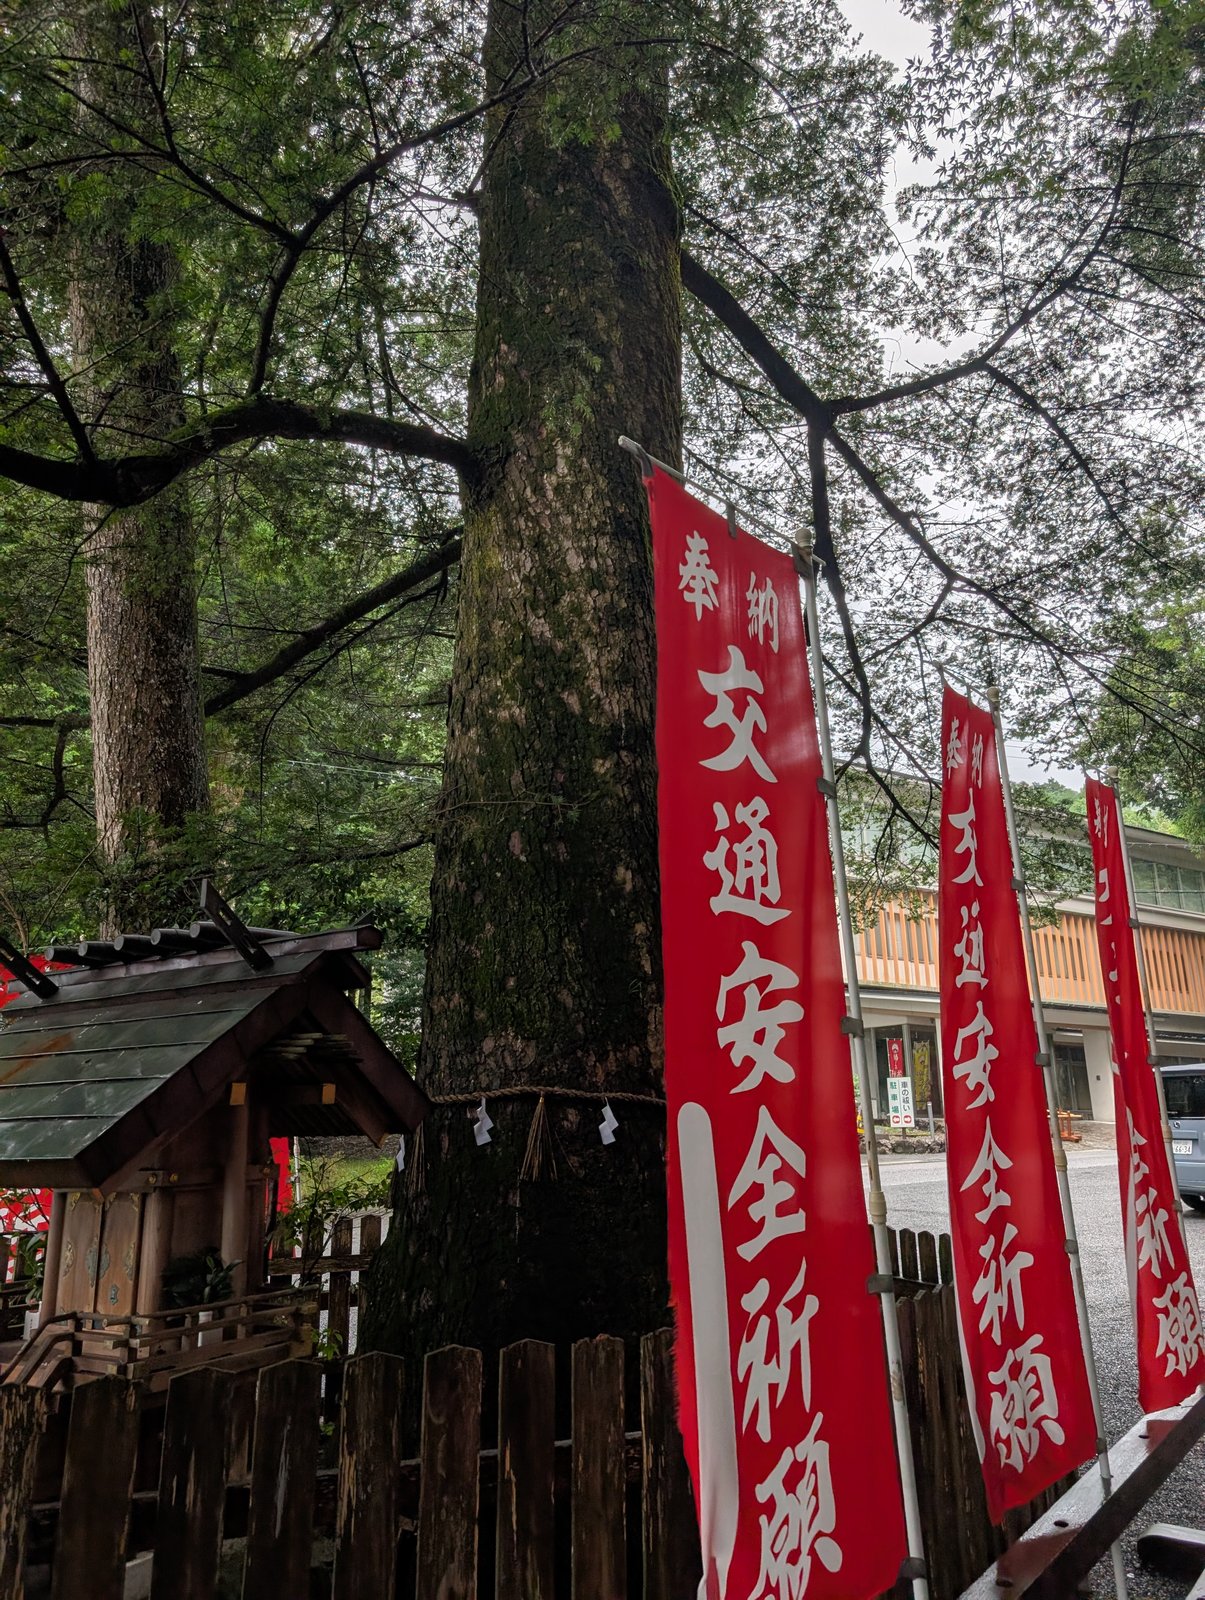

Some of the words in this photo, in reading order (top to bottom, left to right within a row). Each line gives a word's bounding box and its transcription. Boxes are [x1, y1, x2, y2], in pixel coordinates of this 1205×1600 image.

[678, 530, 780, 654] 奉納
[697, 644, 843, 1600] 交通安全祈願
[889, 1081, 900, 1114] 駐車場
[948, 787, 1066, 1474] 交通安全祈願
